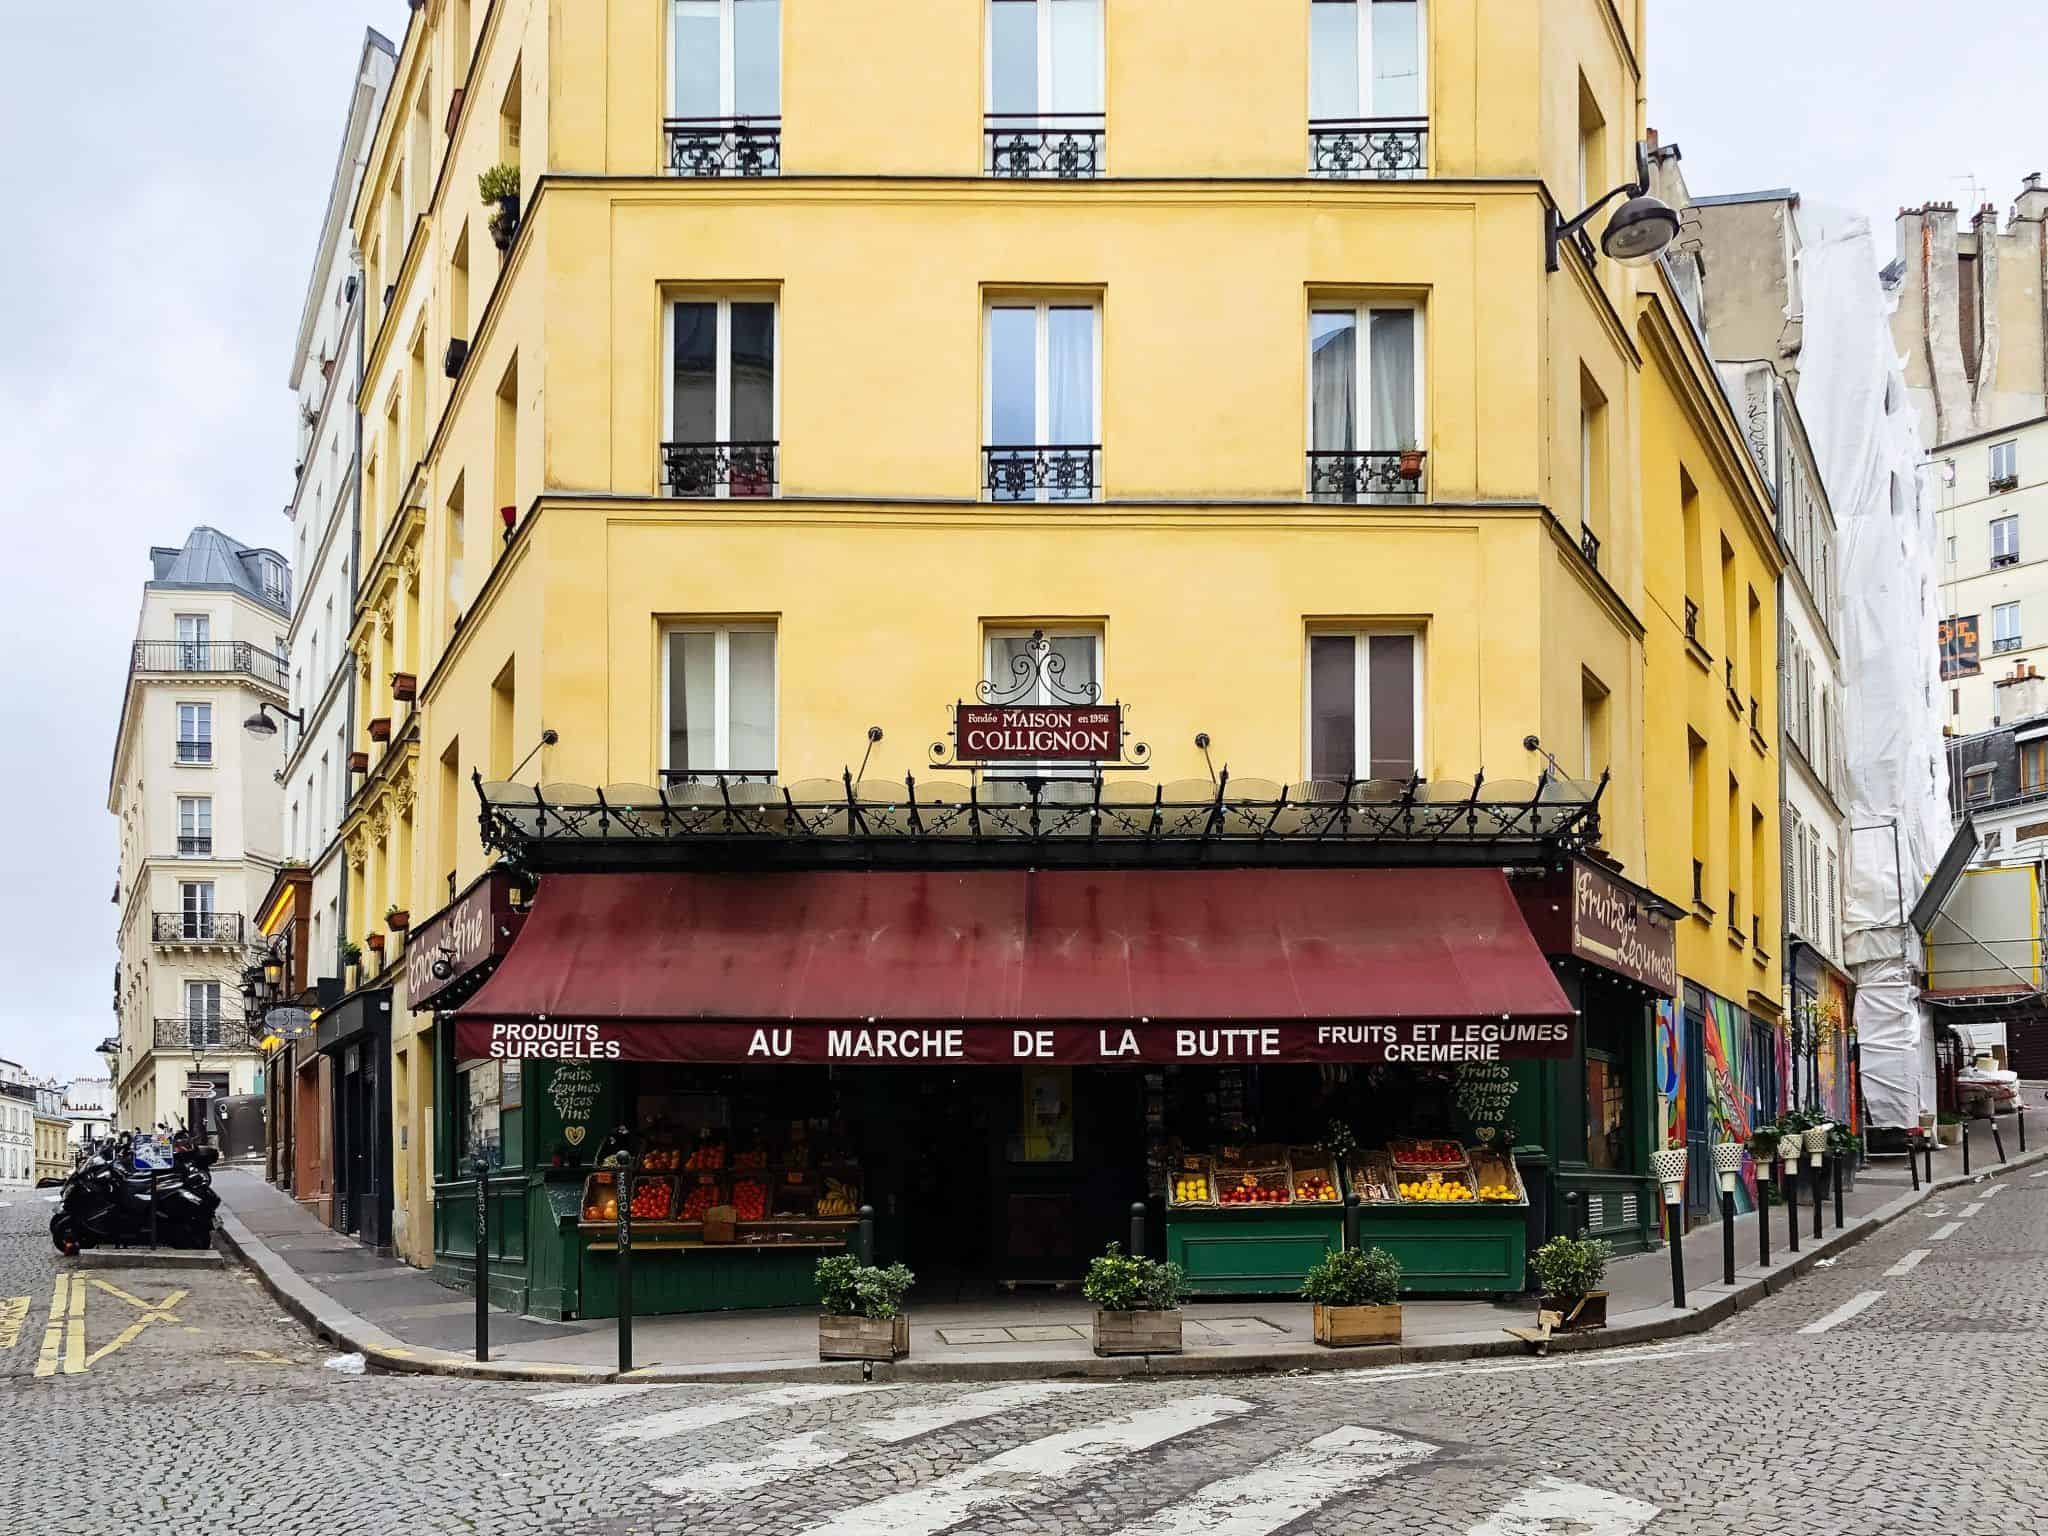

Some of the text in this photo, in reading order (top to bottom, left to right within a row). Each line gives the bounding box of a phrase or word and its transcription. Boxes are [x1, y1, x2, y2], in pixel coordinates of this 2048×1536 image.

[967, 713, 998, 724] Fondée
[1003, 713, 1072, 728] MAISON
[1078, 715, 1089, 724] en
[967, 730, 1110, 751] COLLIGNON
[1578, 871, 1626, 933] Fruits
[492, 1023, 600, 1041] PRODUITS
[1318, 1023, 1569, 1044] FRUITS ET LEGUMES
[489, 1040, 621, 1059] SURGELES
[747, 1028, 1281, 1058] AU MARCHE DE LA BUTTE
[1384, 1043, 1501, 1062] CREMERIE
[1456, 1062, 1511, 1079] Fruits
[556, 1104, 592, 1120] Vins
[1464, 1106, 1506, 1122] Vins
